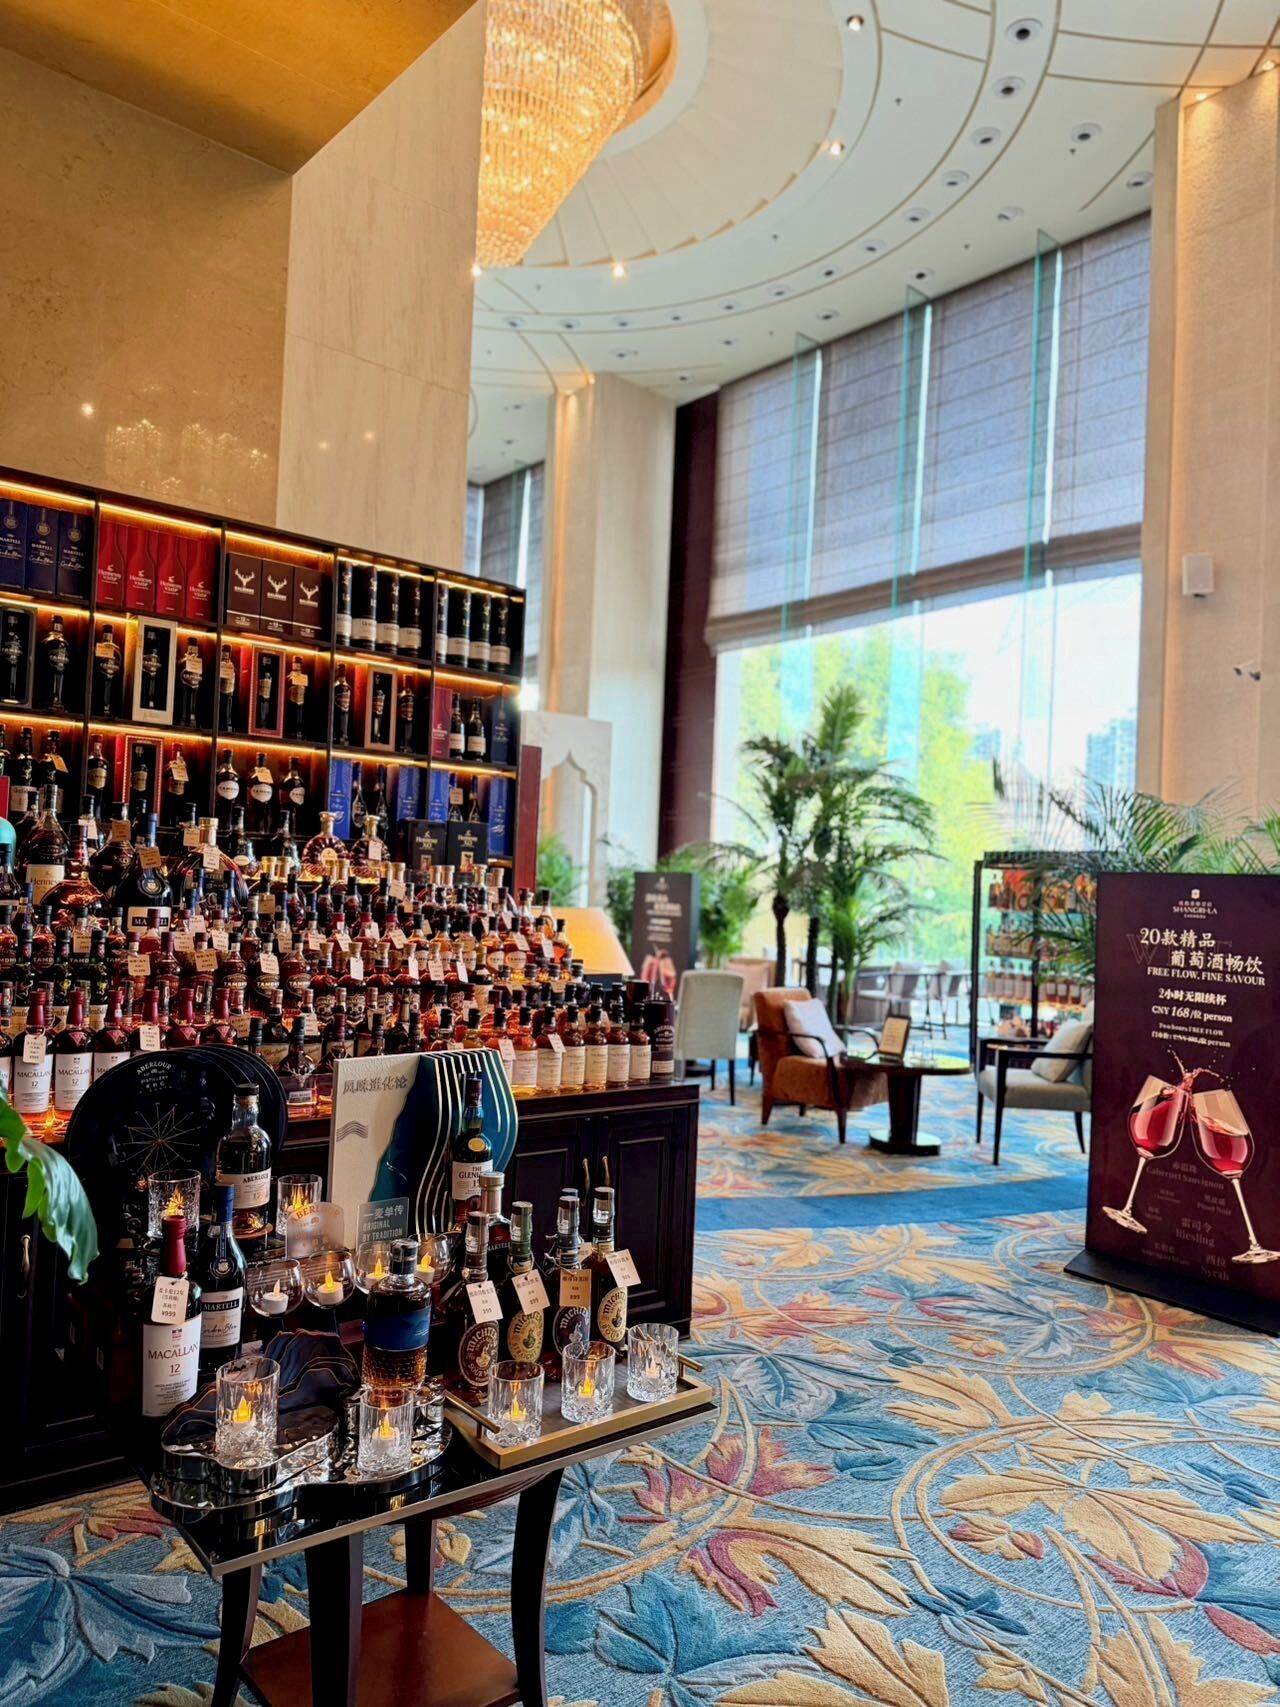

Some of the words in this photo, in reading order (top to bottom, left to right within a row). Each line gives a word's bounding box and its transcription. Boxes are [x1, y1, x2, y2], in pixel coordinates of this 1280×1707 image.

[1172, 905, 1218, 915] SHANGRI-LA
[1140, 927, 1216, 949] 20款精品
[1170, 949, 1264, 975] 葡萄酒畅饮
[1147, 966, 1170, 977] FREE
[1201, 971, 1224, 982] FINE
[1225, 973, 1266, 986] SAVOUR
[1158, 987, 1228, 1006] 2小时无限续杯
[1151, 1005, 1170, 1015] CNY
[1203, 1013, 1233, 1023] person
[136, 1060, 172, 1075] ABERLOUR
[1182, 1174, 1224, 1190] Sauvignon
[362, 1220, 390, 1232] ORIGINAL
[372, 1228, 403, 1241] TRADITION
[1175, 1228, 1216, 1249] Riesling
[203, 1300, 238, 1311] MARTELL
[147, 1341, 199, 1360] MACALLAN
[169, 1363, 181, 1374] 12
